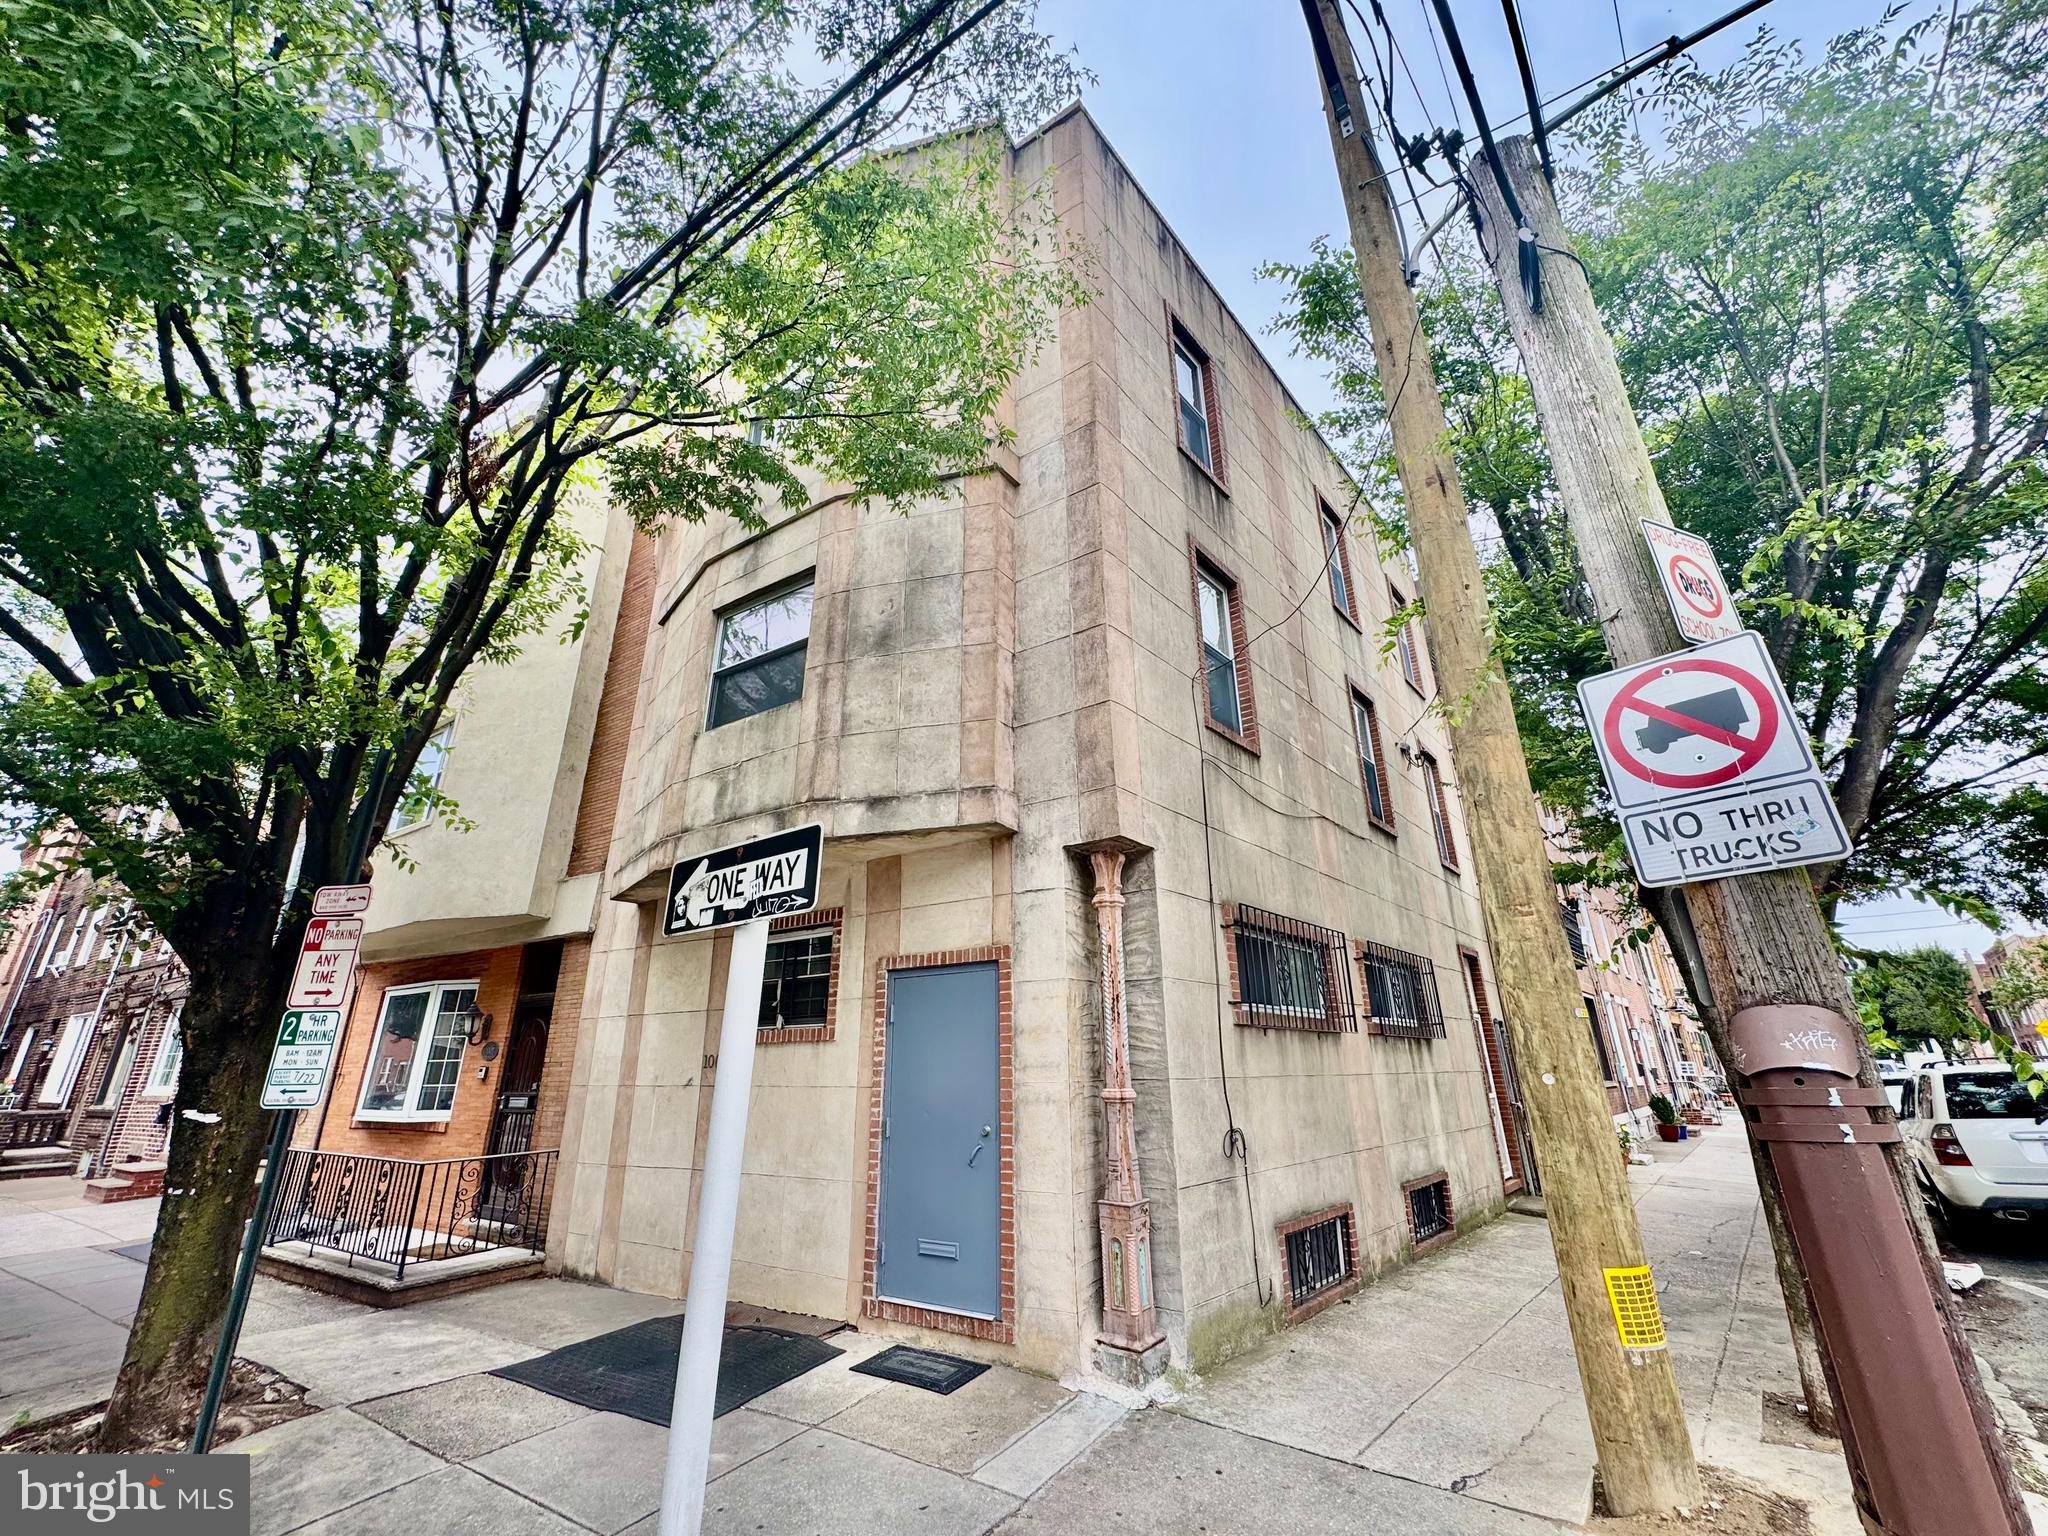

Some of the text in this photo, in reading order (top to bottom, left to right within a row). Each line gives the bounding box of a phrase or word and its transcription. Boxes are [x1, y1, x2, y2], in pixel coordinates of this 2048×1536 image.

[1647, 526, 1711, 560] DRUG-FREE
[1679, 572, 1714, 601] DRUGS
[1681, 615, 1717, 641] SCHOOL
[1641, 796, 1809, 846] NO THRU
[1671, 830, 1802, 869] TRUCKS
[707, 868, 747, 903] ONE
[755, 854, 801, 892] WAY
[306, 927, 359, 944] NO PARKING
[315, 953, 340, 968] ANY
[310, 970, 337, 985] TIME
[282, 1014, 328, 1041] 2 HR
[298, 1029, 334, 1043] PARKING
[285, 1049, 300, 1057] 8AM
[703, 1054, 719, 1069] 10
